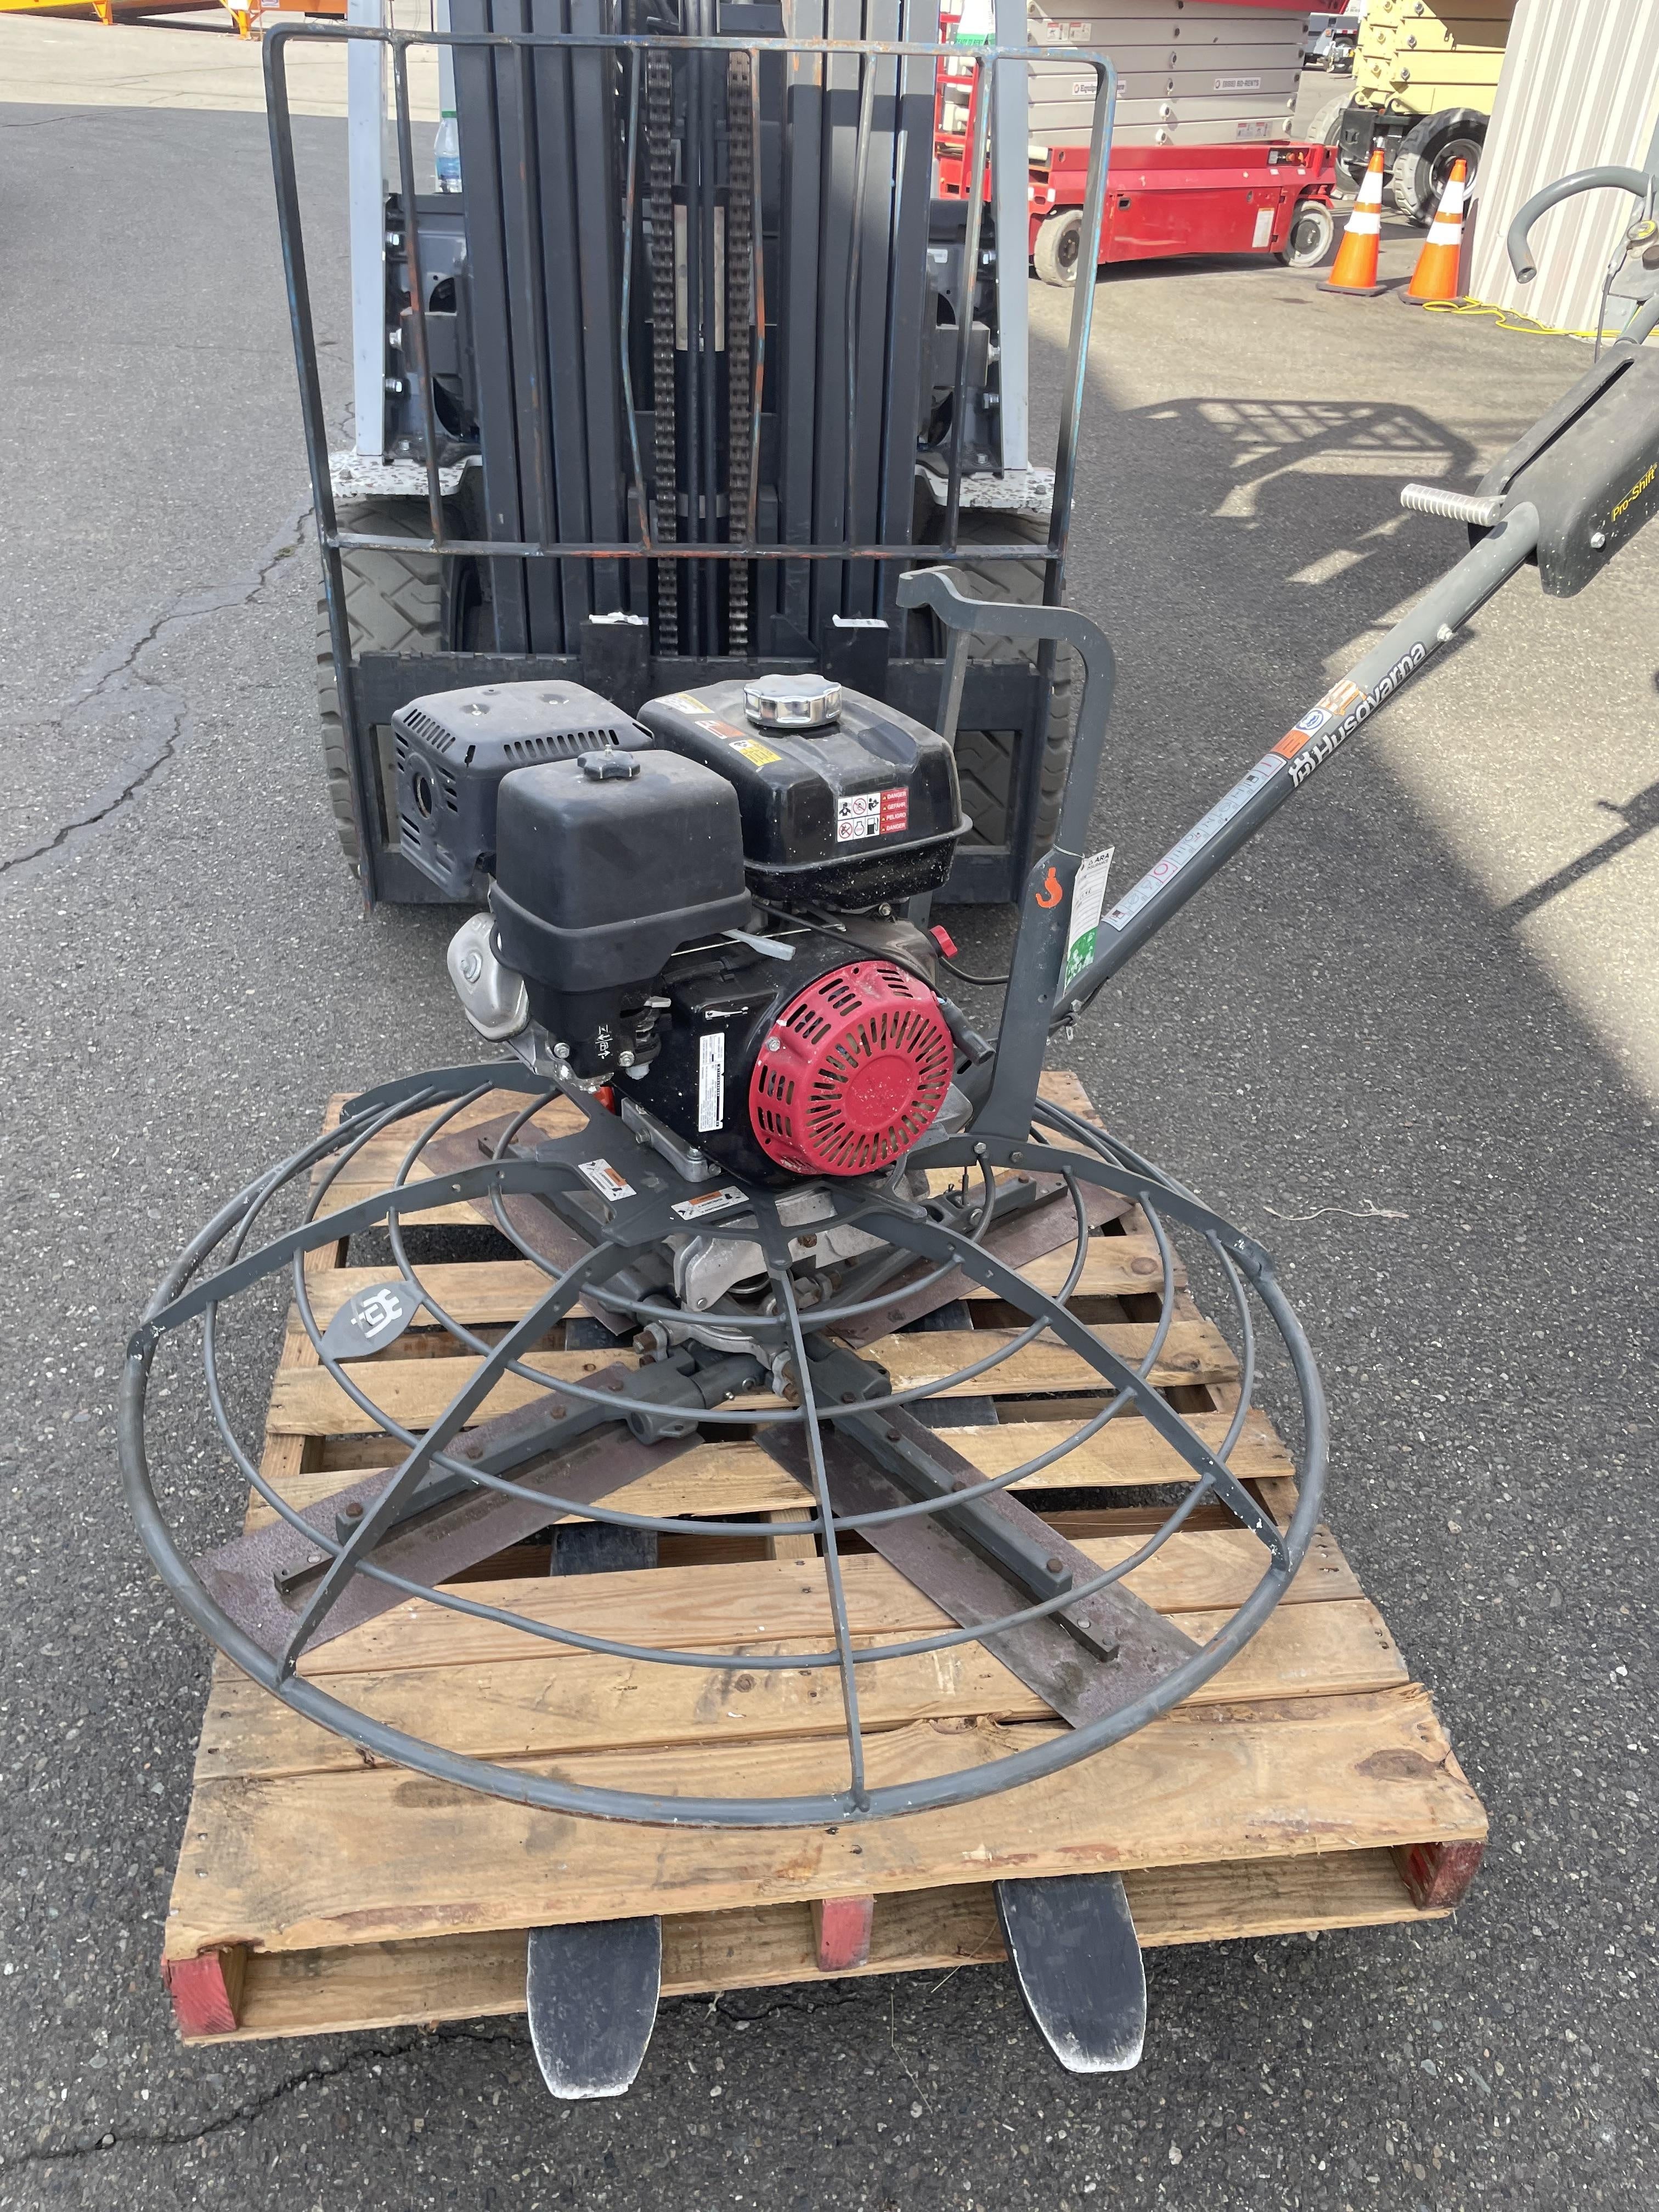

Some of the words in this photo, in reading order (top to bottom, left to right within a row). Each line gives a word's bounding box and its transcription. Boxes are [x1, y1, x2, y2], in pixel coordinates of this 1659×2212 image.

[1313, 642, 1426, 761] Husqvarna
[887, 791, 906, 800] DANGER
[887, 802, 906, 810] GEFAHR
[886, 812, 906, 821] PELIGRO
[886, 822, 906, 831] DANGER
[1094, 853, 1109, 864] ARA
